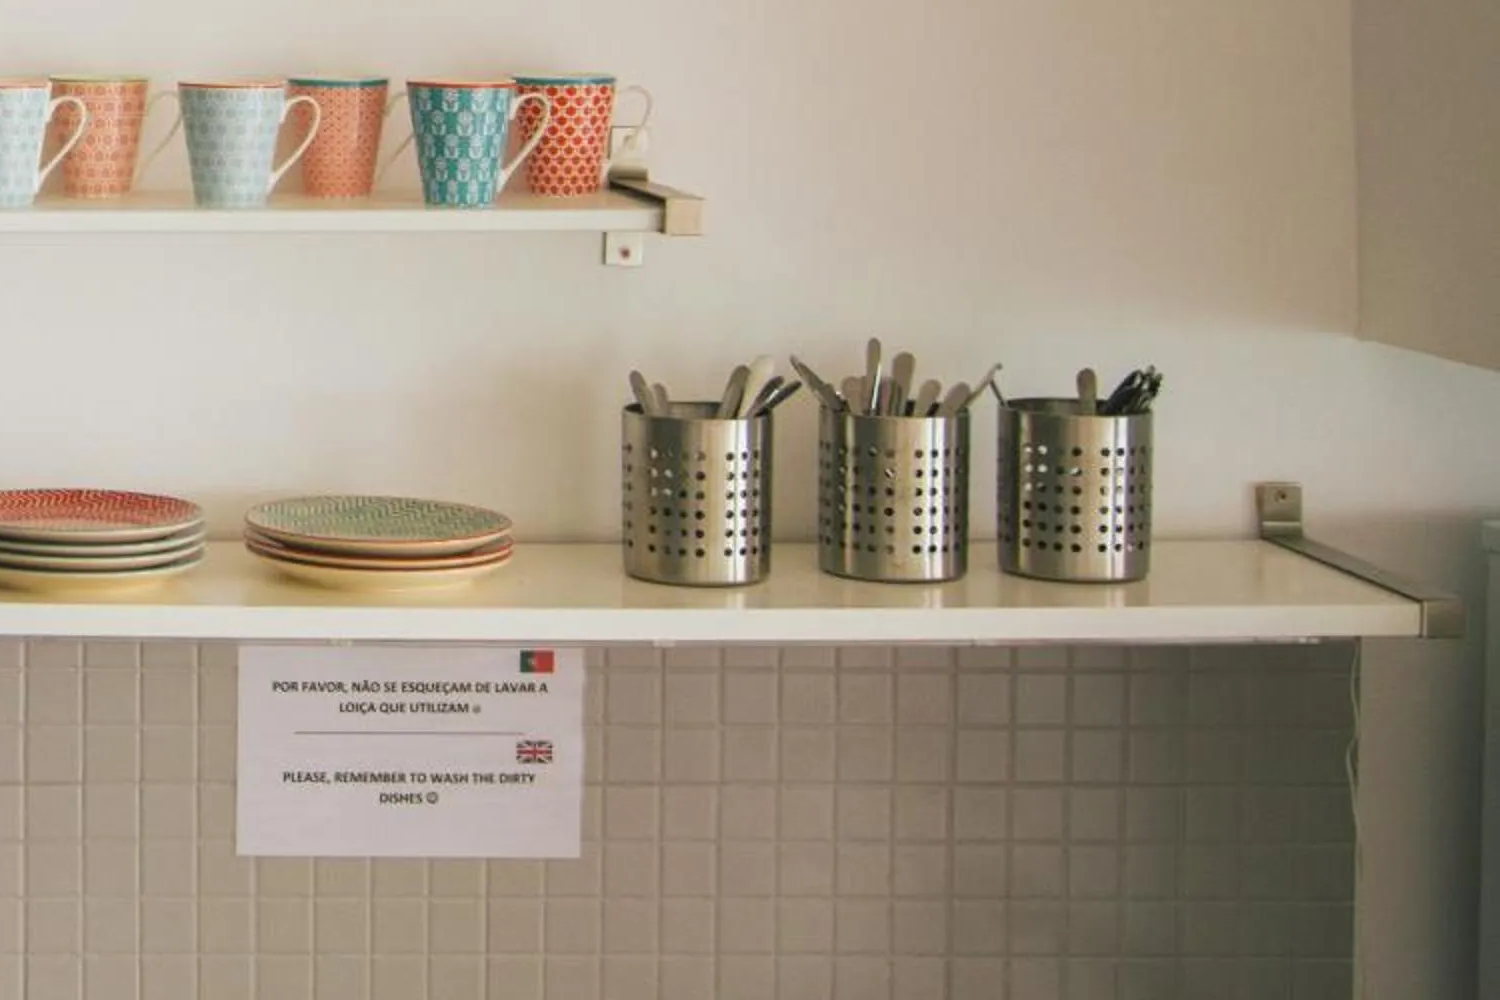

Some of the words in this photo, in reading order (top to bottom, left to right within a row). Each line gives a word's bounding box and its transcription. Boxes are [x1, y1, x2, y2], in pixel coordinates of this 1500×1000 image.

[272, 681, 299, 693] POR
[301, 681, 348, 694] FAVOR,
[351, 679, 381, 693] NÃO
[383, 681, 397, 693] SE
[401, 681, 472, 695] ESQUEÇAM
[474, 682, 490, 693] DE
[494, 682, 536, 693] LAVAR
[539, 682, 549, 693] A
[339, 702, 376, 714] LOIÇA
[379, 702, 406, 714] QUE
[409, 703, 469, 713] UTILIZAM
[282, 771, 331, 784] PLEASE,
[334, 772, 406, 783] REMEMBER
[409, 773, 427, 784] TO
[430, 773, 469, 784] WASH
[472, 773, 494, 784] THE
[499, 773, 536, 784] DIRTY
[379, 792, 422, 804] DISHES
